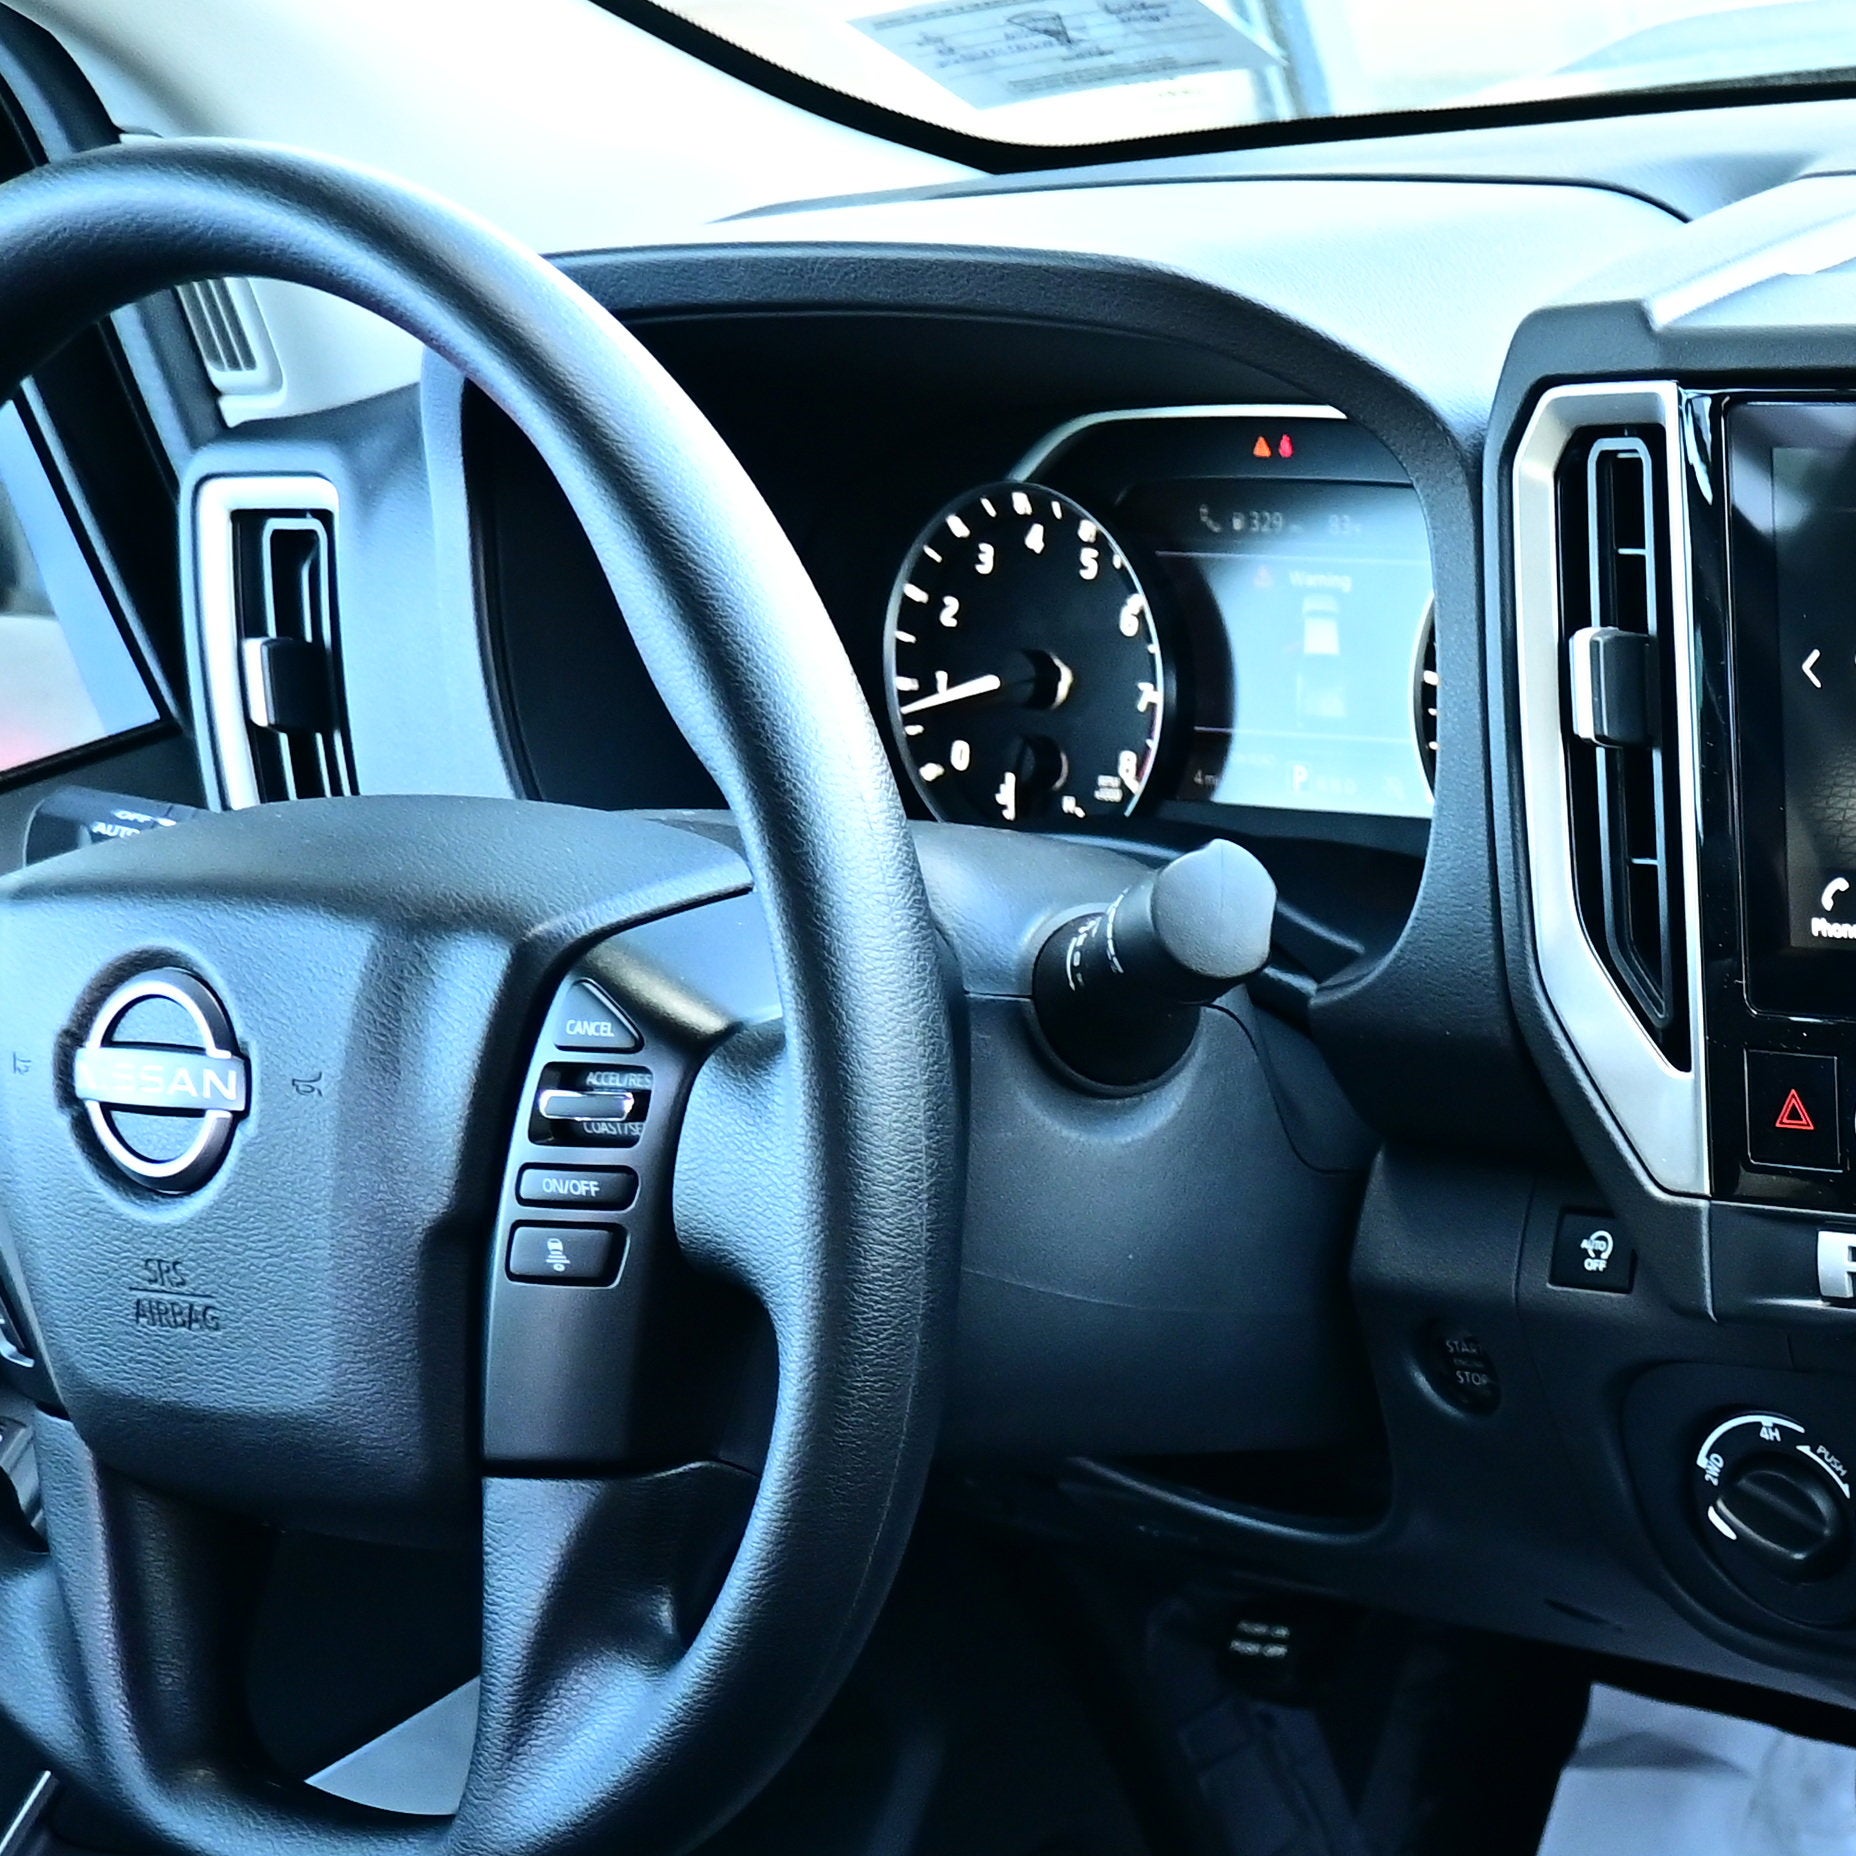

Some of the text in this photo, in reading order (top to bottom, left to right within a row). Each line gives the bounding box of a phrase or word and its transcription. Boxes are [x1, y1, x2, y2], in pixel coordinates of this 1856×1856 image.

[1025, 523, 1044, 553] 4
[975, 542, 994, 575] 3
[1080, 548, 1098, 580] 5
[940, 597, 959, 626] 2
[951, 740, 970, 770] 0
[566, 1019, 615, 1037] CANCEL
[586, 1071, 651, 1087] ACCEL/RES
[542, 1177, 600, 1198] ON/OFF
[144, 1259, 186, 1288] SRS
[1584, 1258, 1607, 1272] OFF
[135, 1298, 219, 1331] AIRBAG
[1759, 1425, 1781, 1443] 4H
[1704, 1453, 1726, 1486] 2WD
[1816, 1445, 1848, 1478] PUSH
